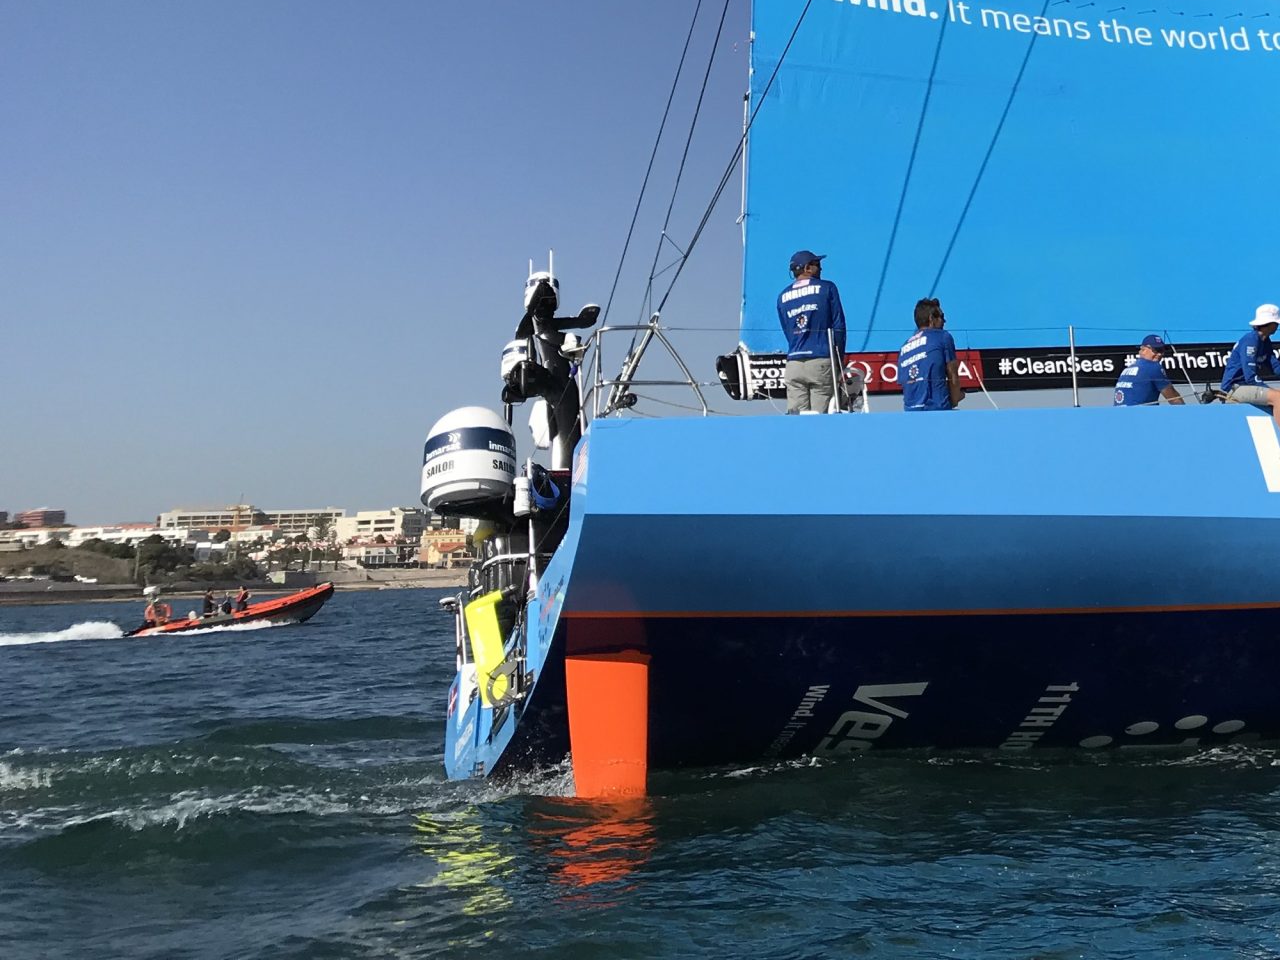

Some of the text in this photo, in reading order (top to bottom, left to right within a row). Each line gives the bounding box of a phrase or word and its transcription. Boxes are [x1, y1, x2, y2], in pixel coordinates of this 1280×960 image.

[981, 7, 1091, 40] means
[1098, 17, 1153, 47] the
[1160, 25, 1250, 52] world
[998, 352, 1114, 374] #CleanSeas
[426, 460, 455, 479] SAILOR
[1019, 682, 1080, 727] 11TH
